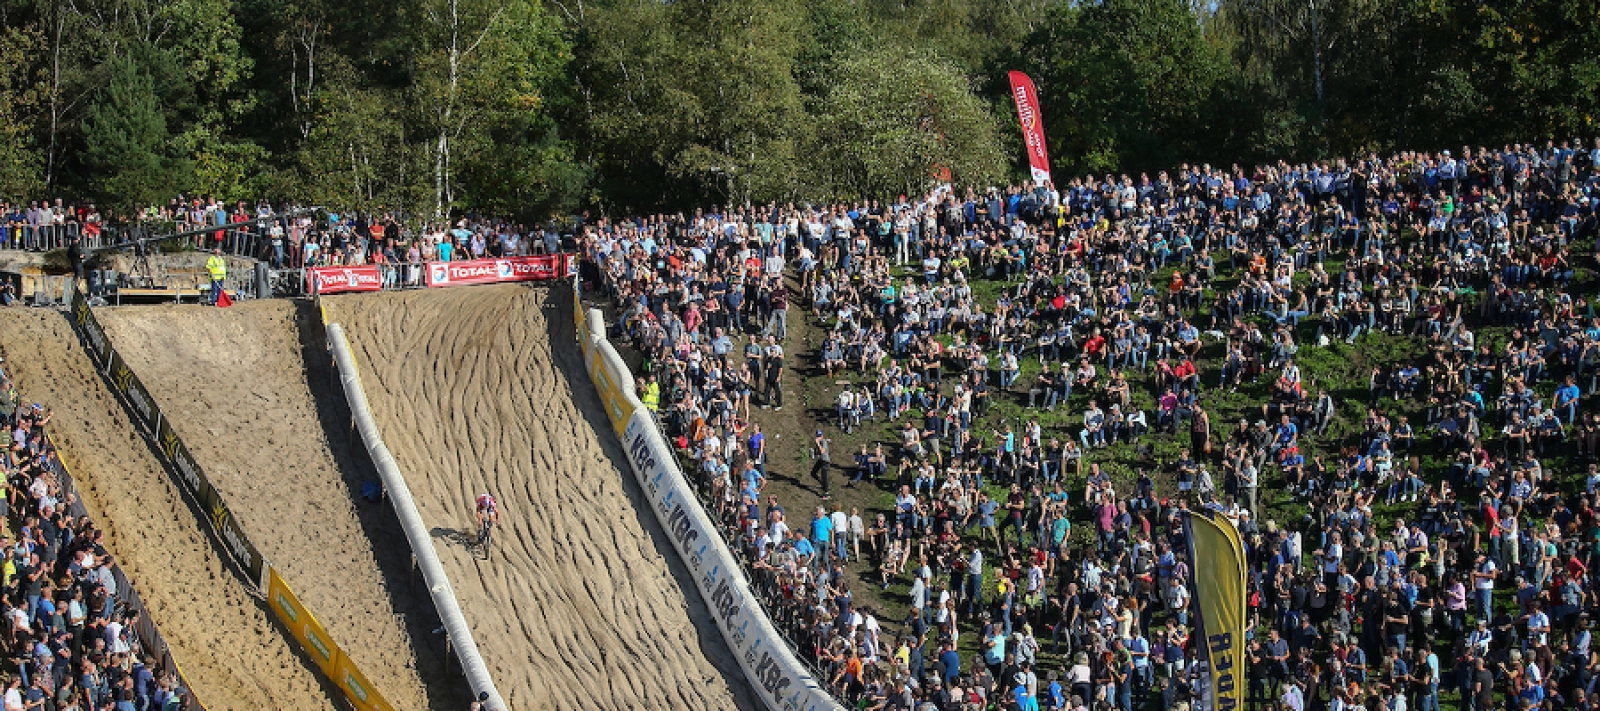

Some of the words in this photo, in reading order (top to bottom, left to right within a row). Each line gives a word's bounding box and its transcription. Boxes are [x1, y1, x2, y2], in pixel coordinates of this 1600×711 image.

[321, 274, 347, 285] TOTAL
[450, 266, 495, 278] TOTAL
[514, 263, 552, 273] TOTAL
[630, 434, 655, 483] KBC
[668, 502, 698, 556] KBC
[710, 577, 740, 632] KBC
[755, 651, 791, 704] KBC
